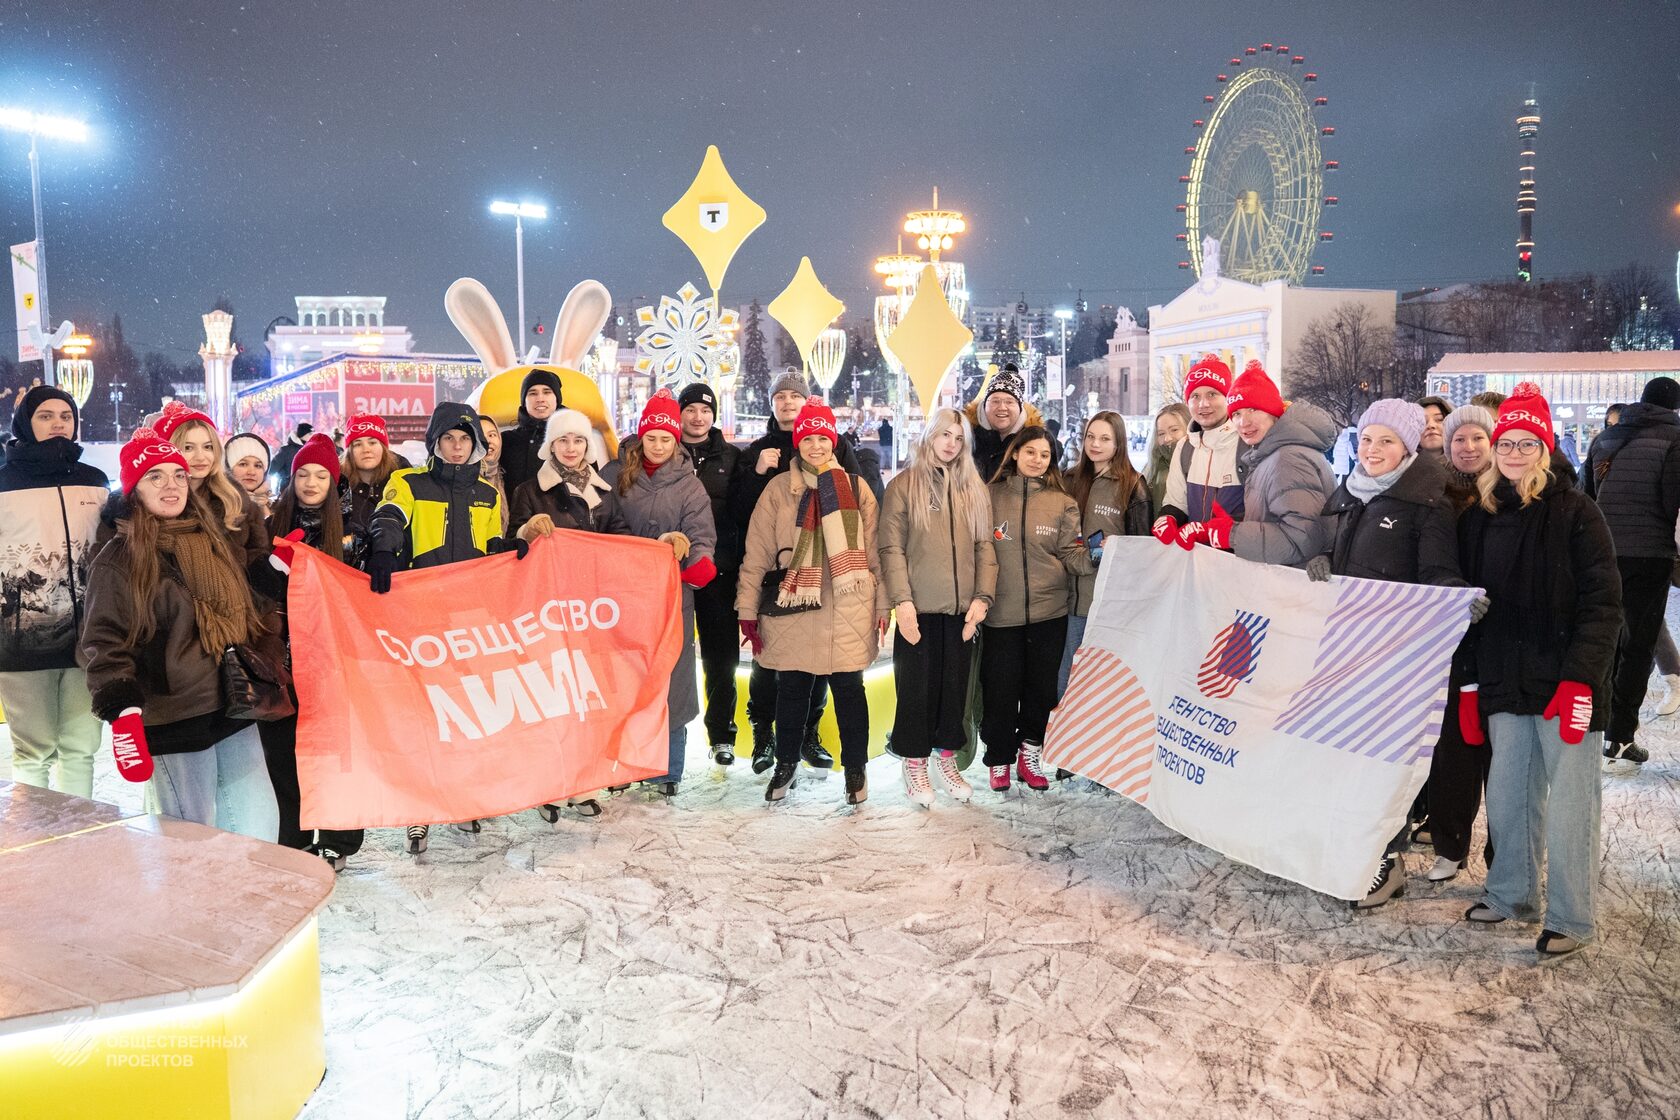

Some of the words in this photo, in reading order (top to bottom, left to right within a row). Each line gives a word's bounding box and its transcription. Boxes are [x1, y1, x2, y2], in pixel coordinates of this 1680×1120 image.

[354, 397, 426, 416] ЗИМА
[132, 442, 185, 469] МОСК
[376, 597, 621, 668] СООБЩЕСТВО
[1168, 695, 1237, 736] ГЕНТСТВО
[1157, 714, 1240, 768] БЩЕСТВЕННЫХ
[1156, 744, 1206, 785] ПРОЕКТОВ
